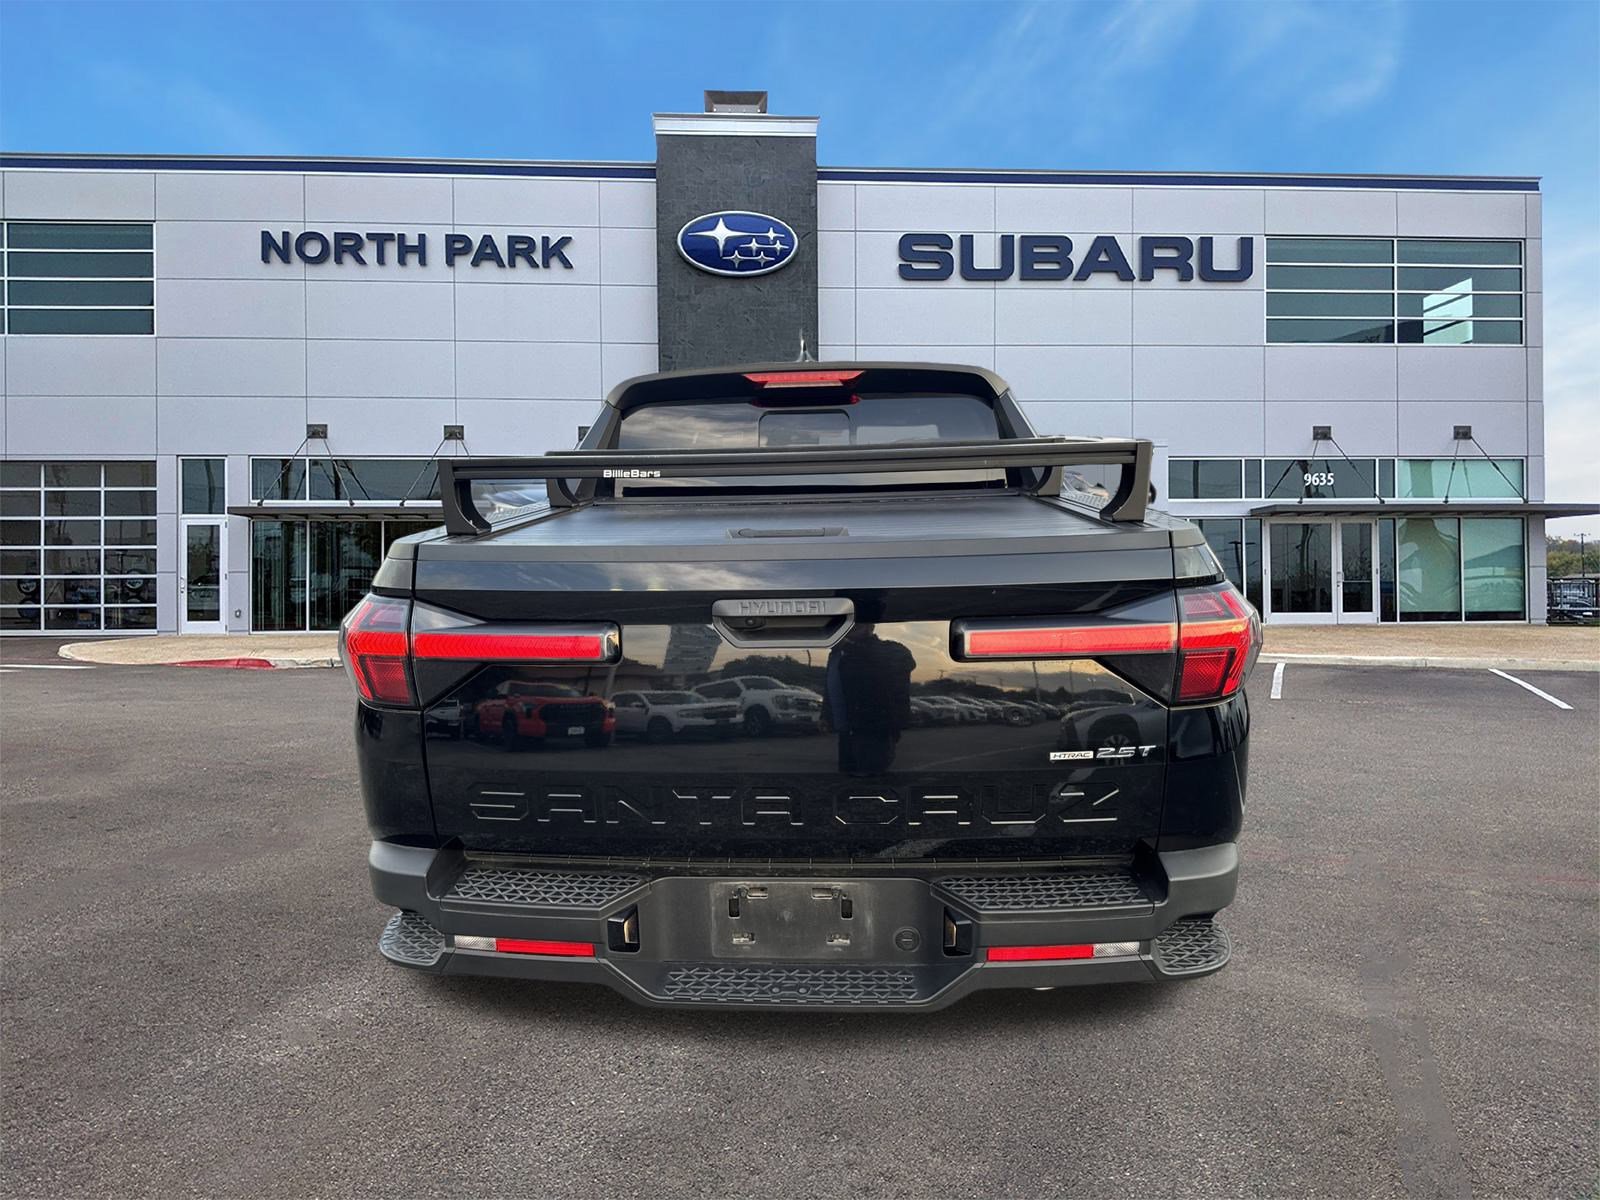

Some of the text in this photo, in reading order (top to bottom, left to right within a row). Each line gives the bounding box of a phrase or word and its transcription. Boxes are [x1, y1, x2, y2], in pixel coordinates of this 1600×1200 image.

[260, 230, 574, 269] NORTH PARK
[899, 233, 1254, 282] SUBARU
[603, 469, 661, 478] BillieBars
[1303, 472, 1335, 486] 9635
[739, 600, 826, 614] HYUNDAI
[1050, 751, 1094, 760] HTRAC
[467, 782, 1120, 826] SANTA CRUZ
